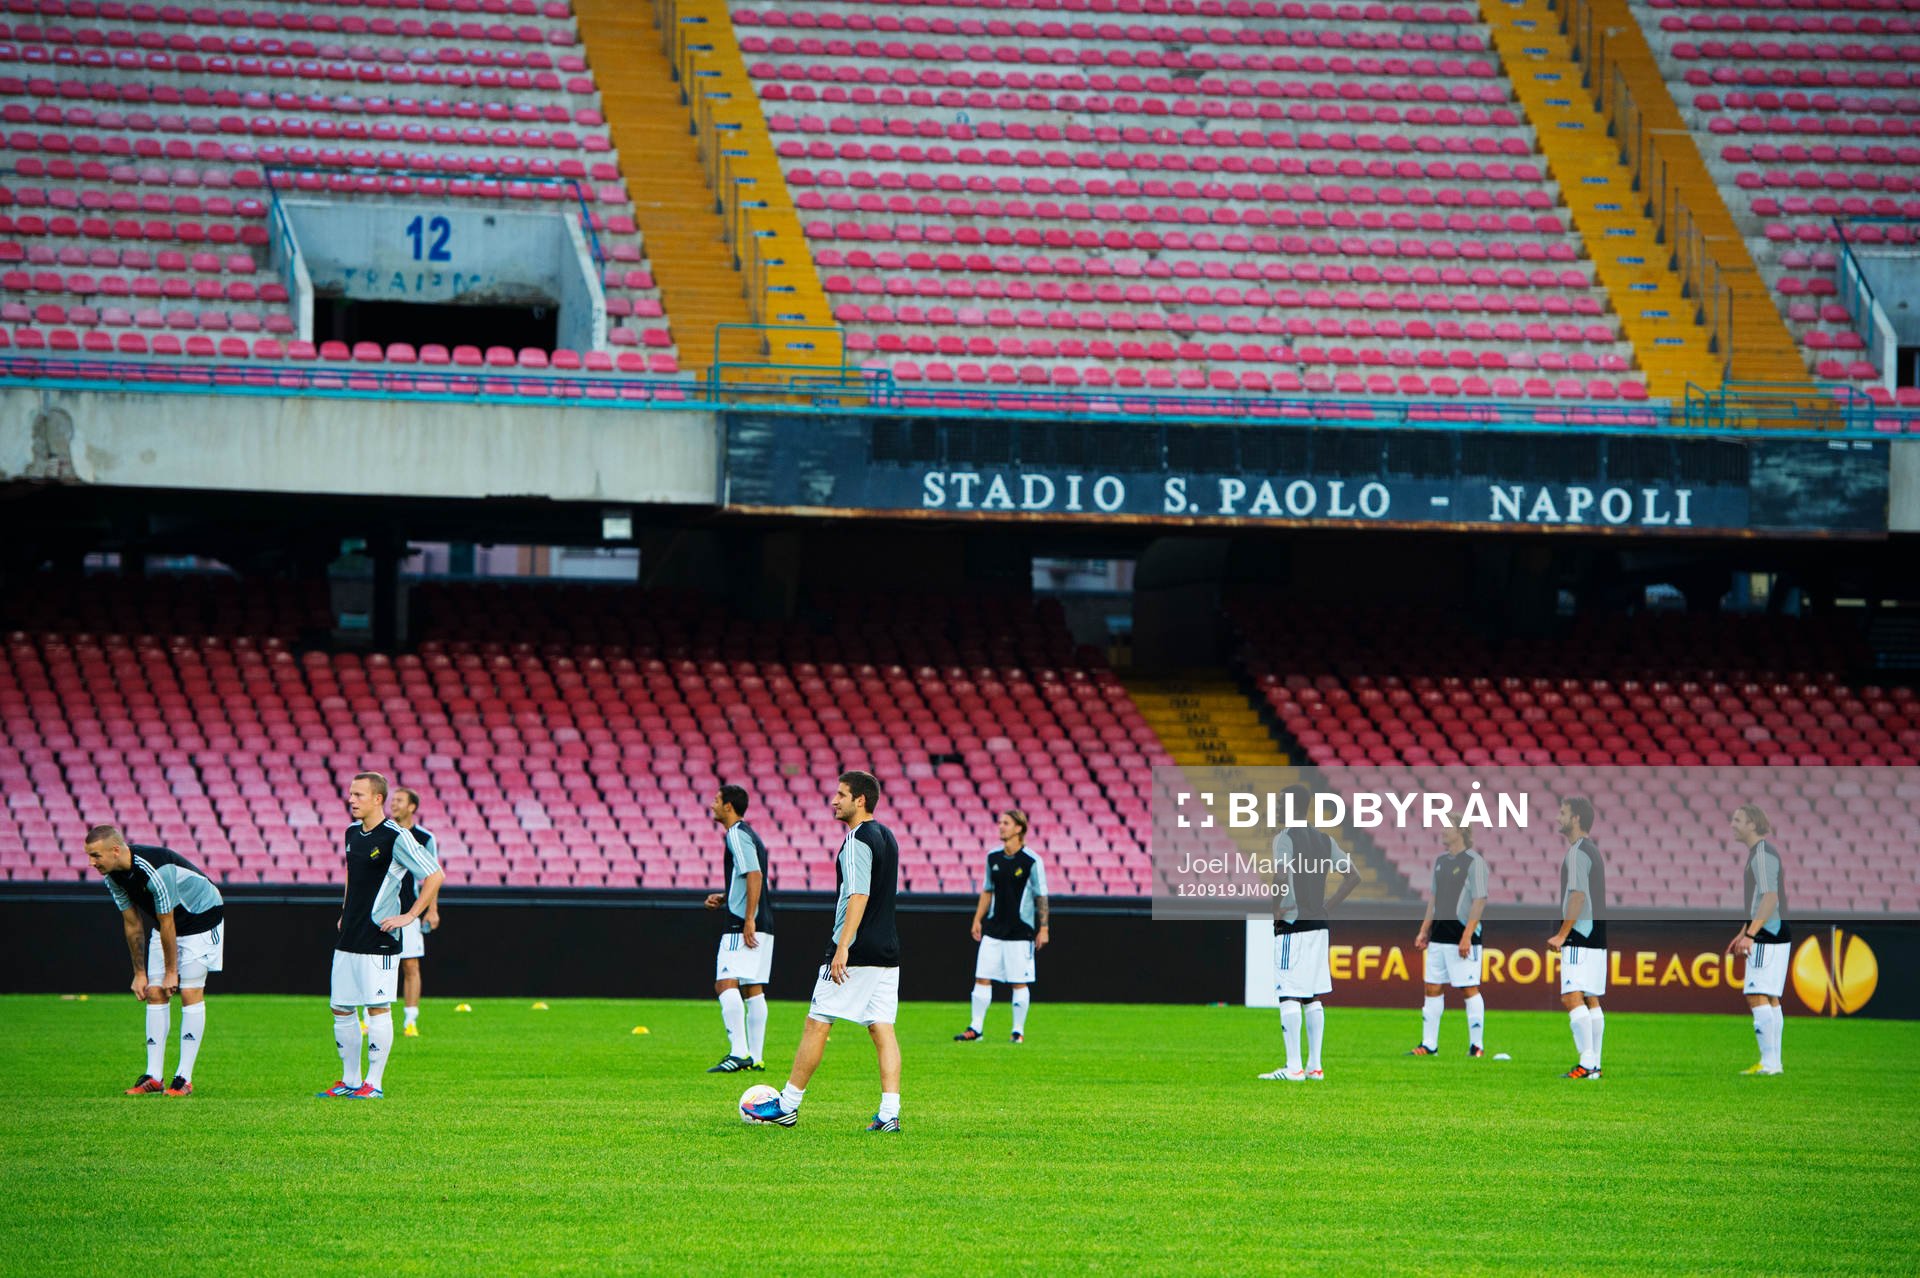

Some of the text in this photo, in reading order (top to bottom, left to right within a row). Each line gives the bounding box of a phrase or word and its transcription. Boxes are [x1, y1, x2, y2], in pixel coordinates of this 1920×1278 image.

[406, 215, 452, 262] 12
[922, 471, 1126, 512] STADIO
[1163, 476, 1200, 513] S.
[1218, 478, 1391, 521] PAOLO
[1489, 484, 1693, 526] NAPOLI
[1329, 945, 1410, 981] EFA
[1610, 950, 1745, 989] LEAGU
